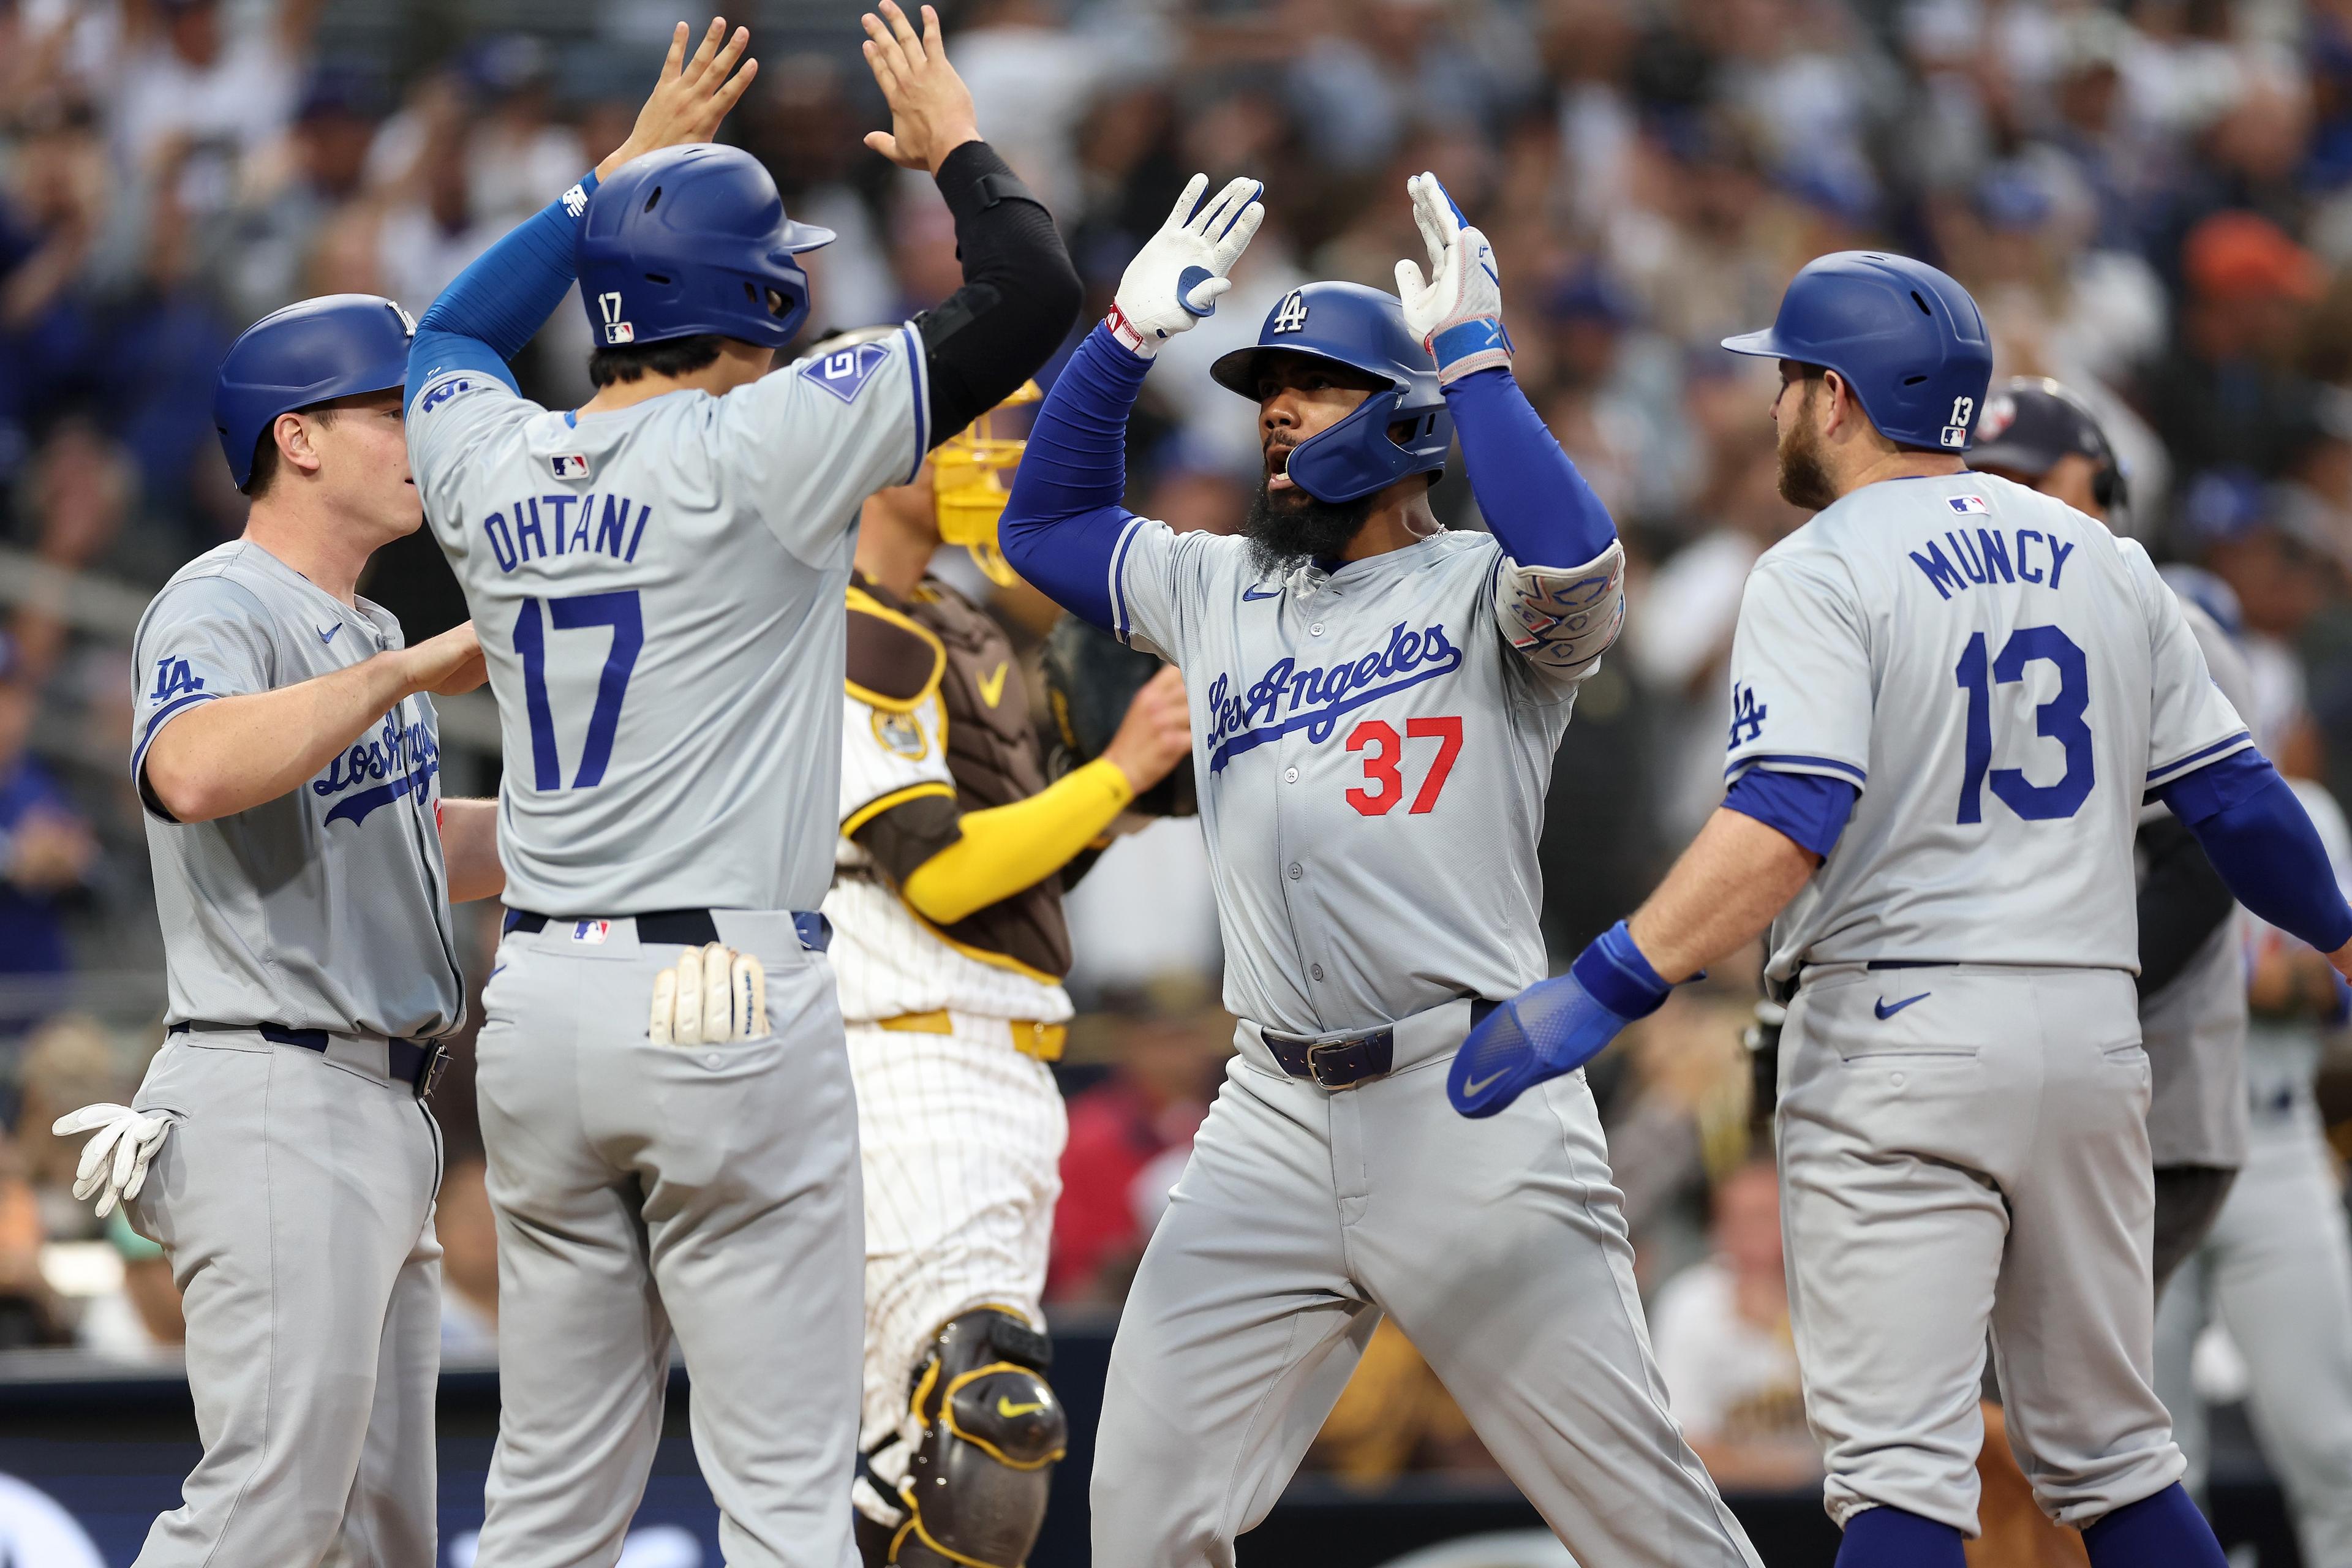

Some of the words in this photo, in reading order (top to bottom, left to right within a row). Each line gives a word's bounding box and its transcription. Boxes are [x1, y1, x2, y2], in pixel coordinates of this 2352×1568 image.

[598, 291, 622, 323] 17
[1274, 288, 1308, 333] LA
[1950, 396, 1973, 426] 13
[484, 494, 652, 573] OHTANI
[1909, 528, 2075, 600] MUNCY
[150, 655, 205, 706] LA
[513, 590, 644, 791] 17
[1207, 672, 1242, 750] Los
[1243, 620, 1457, 744] Angeles
[1727, 677, 1767, 751] LA
[1955, 625, 2095, 824] 13
[313, 745, 386, 796] Los
[1346, 715, 1463, 816] 37
